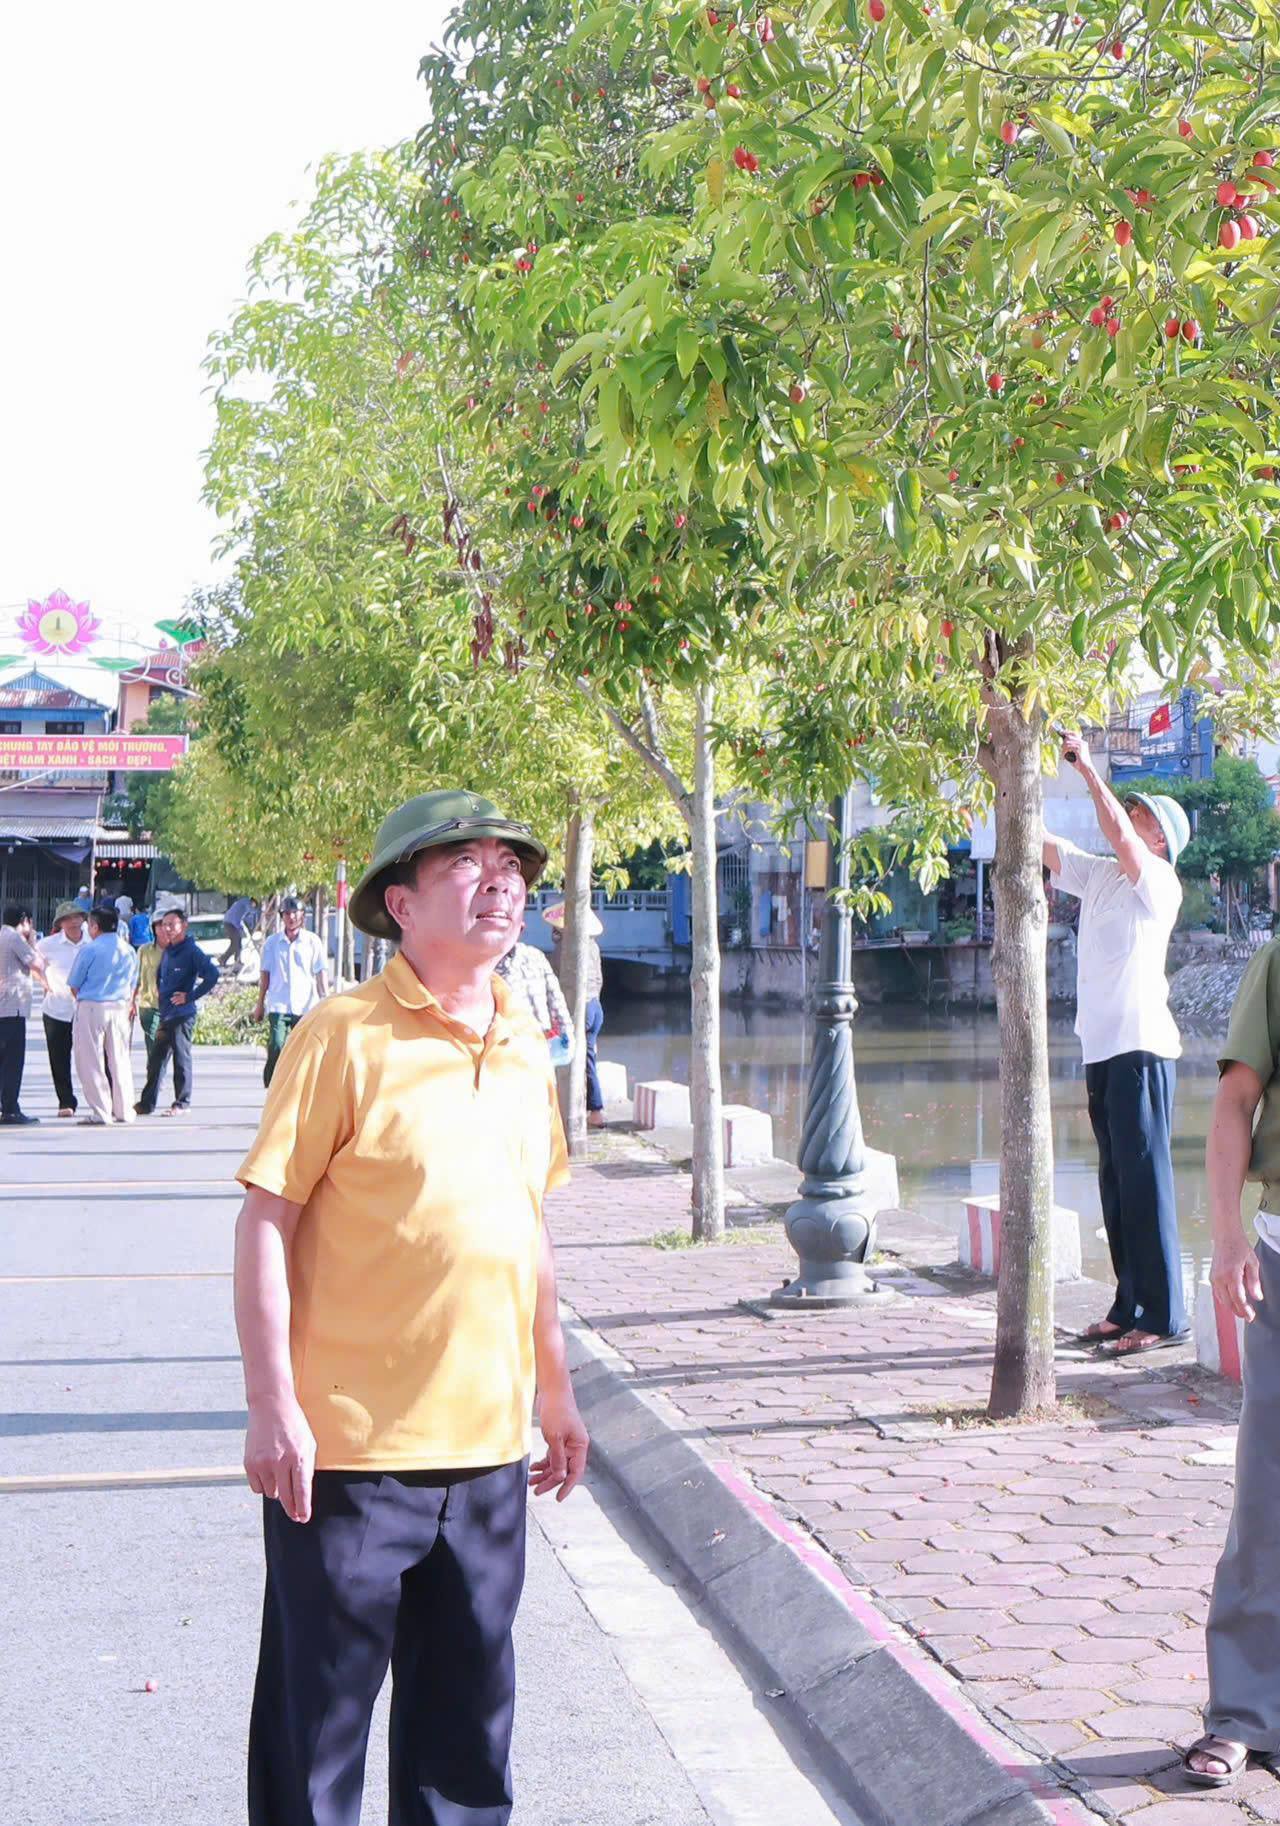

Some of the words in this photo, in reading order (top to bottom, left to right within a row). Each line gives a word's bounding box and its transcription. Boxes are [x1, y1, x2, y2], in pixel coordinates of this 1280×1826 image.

[37, 741, 53, 752] TAY
[56, 738, 79, 752] BẢO
[82, 739, 95, 753] VỆ
[97, 739, 119, 752] MÔI
[19, 755, 44, 765] NAM
[47, 755, 77, 765] XANH
